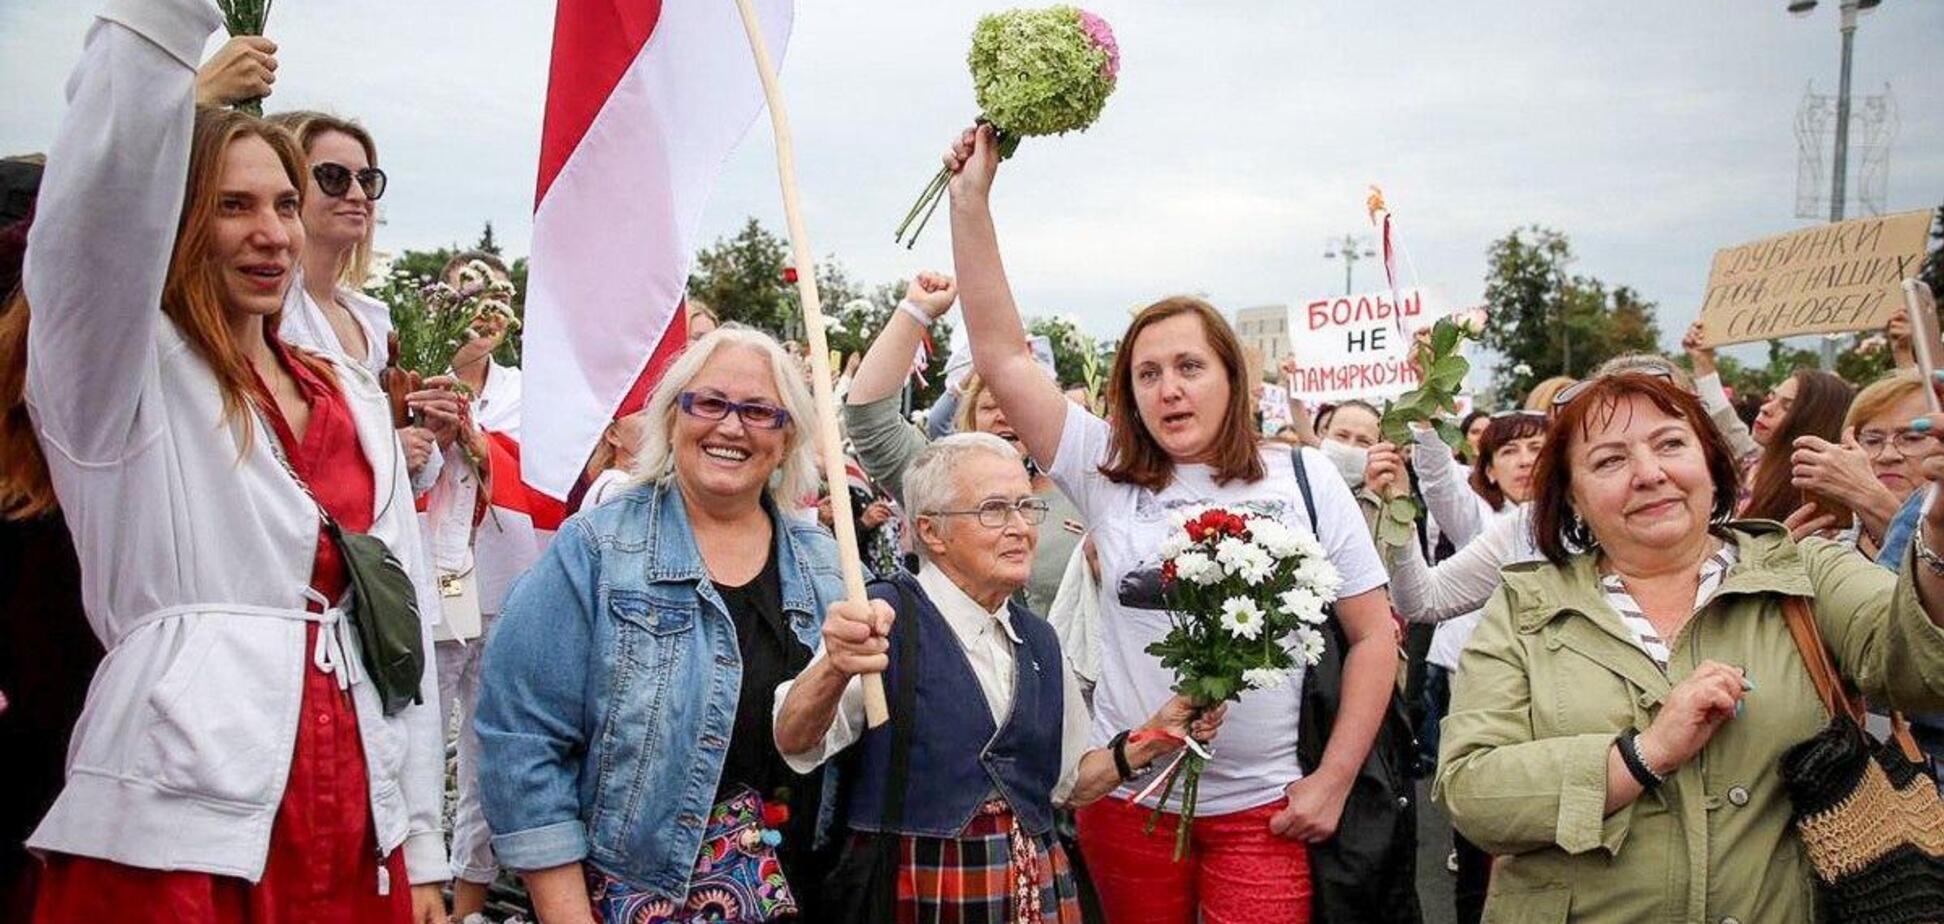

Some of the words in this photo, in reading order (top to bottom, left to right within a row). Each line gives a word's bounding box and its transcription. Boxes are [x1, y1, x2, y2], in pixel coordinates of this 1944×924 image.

[1723, 221, 1884, 277] ДУБИНКИ
[1801, 254, 1917, 293] НАШИХ
[1307, 291, 1422, 331] БОЛЬШ
[1727, 289, 1887, 338] СЫНОВЕЙ
[1347, 327, 1387, 353] НЕ
[1293, 356, 1419, 393] ПАМЯРКОЎН
